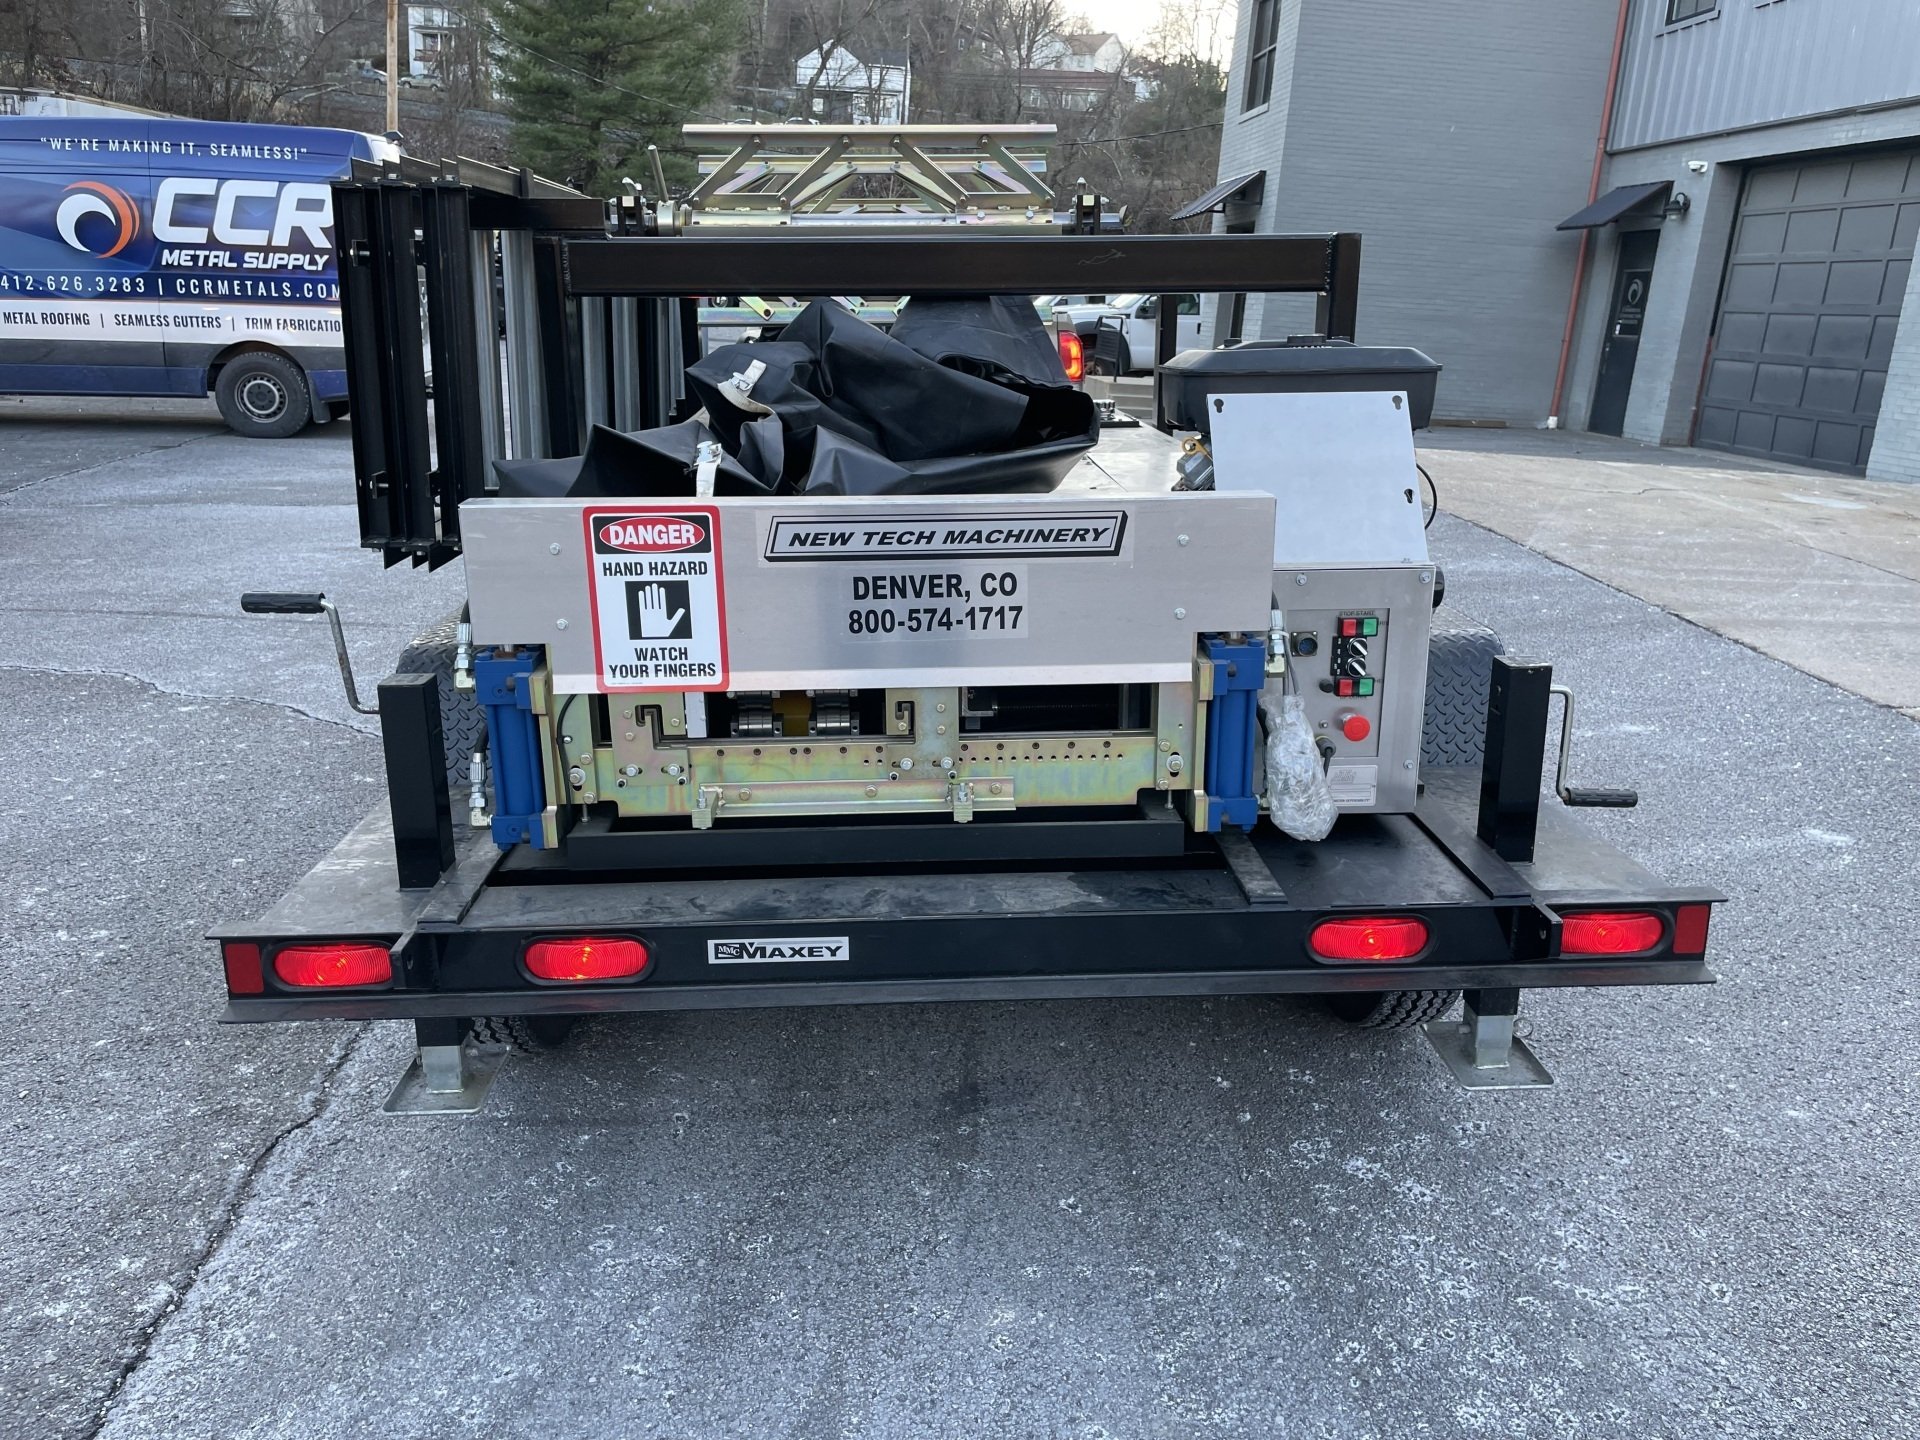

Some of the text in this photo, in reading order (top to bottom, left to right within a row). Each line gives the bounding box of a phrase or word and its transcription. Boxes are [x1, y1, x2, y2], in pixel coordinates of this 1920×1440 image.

[108, 139, 172, 154] MAKING
[181, 142, 202, 157] IT,
[152, 177, 334, 249] CCR
[161, 249, 330, 271] METAL SUPPLY
[0, 275, 146, 293] 412.626.3283
[3, 311, 91, 326] METAL ROOFING
[114, 313, 222, 329] SEAMLESS GUTTERS
[245, 317, 342, 333] TRIM FABRICATIO
[608, 524, 696, 546] DANGER
[788, 527, 1111, 547] NEW TECH MACHINERY
[602, 561, 709, 577] HAND HAZARD
[852, 572, 1018, 602] DENVER, CO
[848, 605, 1024, 634] 800-574-1717
[634, 647, 689, 662] WATCH
[608, 662, 717, 679] YOUR FINGERS
[742, 942, 844, 959] MAXEY
